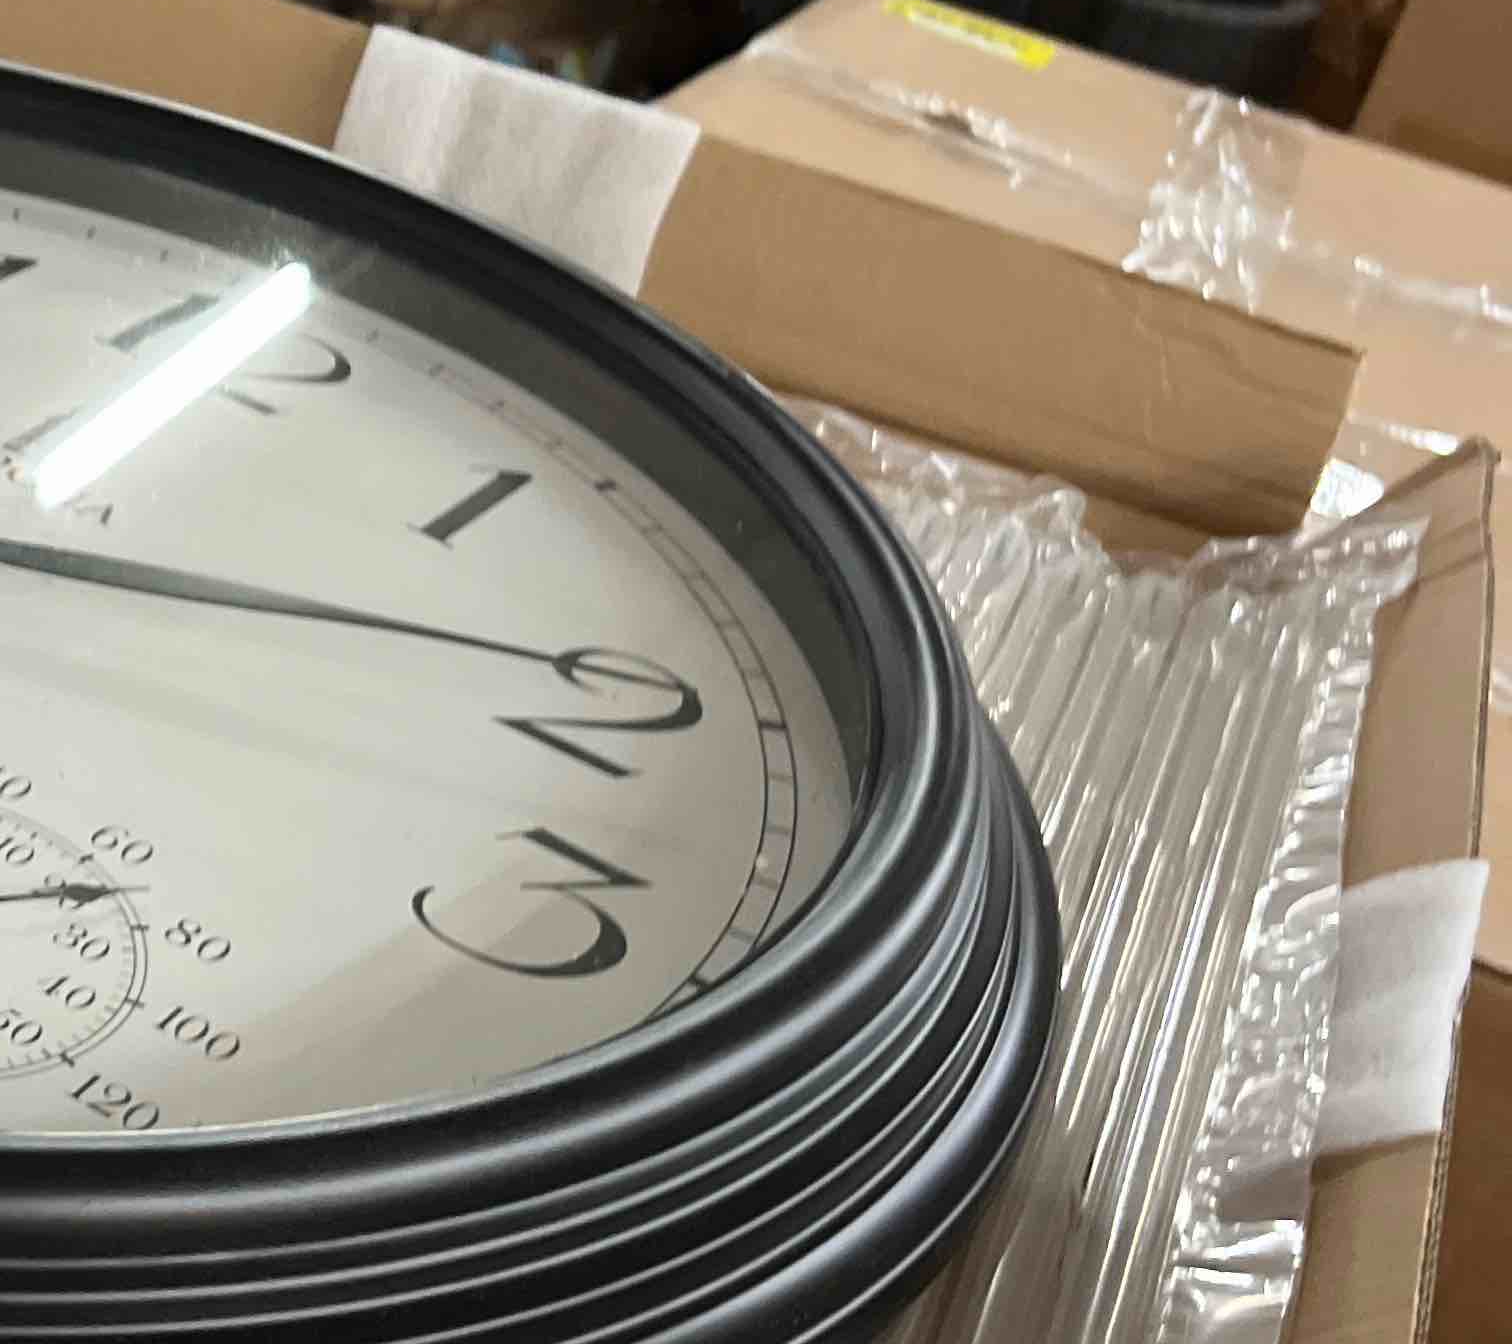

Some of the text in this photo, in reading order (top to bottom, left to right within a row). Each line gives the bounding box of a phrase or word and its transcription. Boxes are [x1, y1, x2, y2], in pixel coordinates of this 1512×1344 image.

[408, 464, 532, 549] 1
[491, 646, 702, 778] 2
[90, 824, 154, 866] 60
[412, 828, 652, 978] 3
[51, 922, 112, 962] 30
[163, 916, 232, 963] 80
[156, 1005, 241, 1062] 100
[70, 1074, 161, 1131] 120
